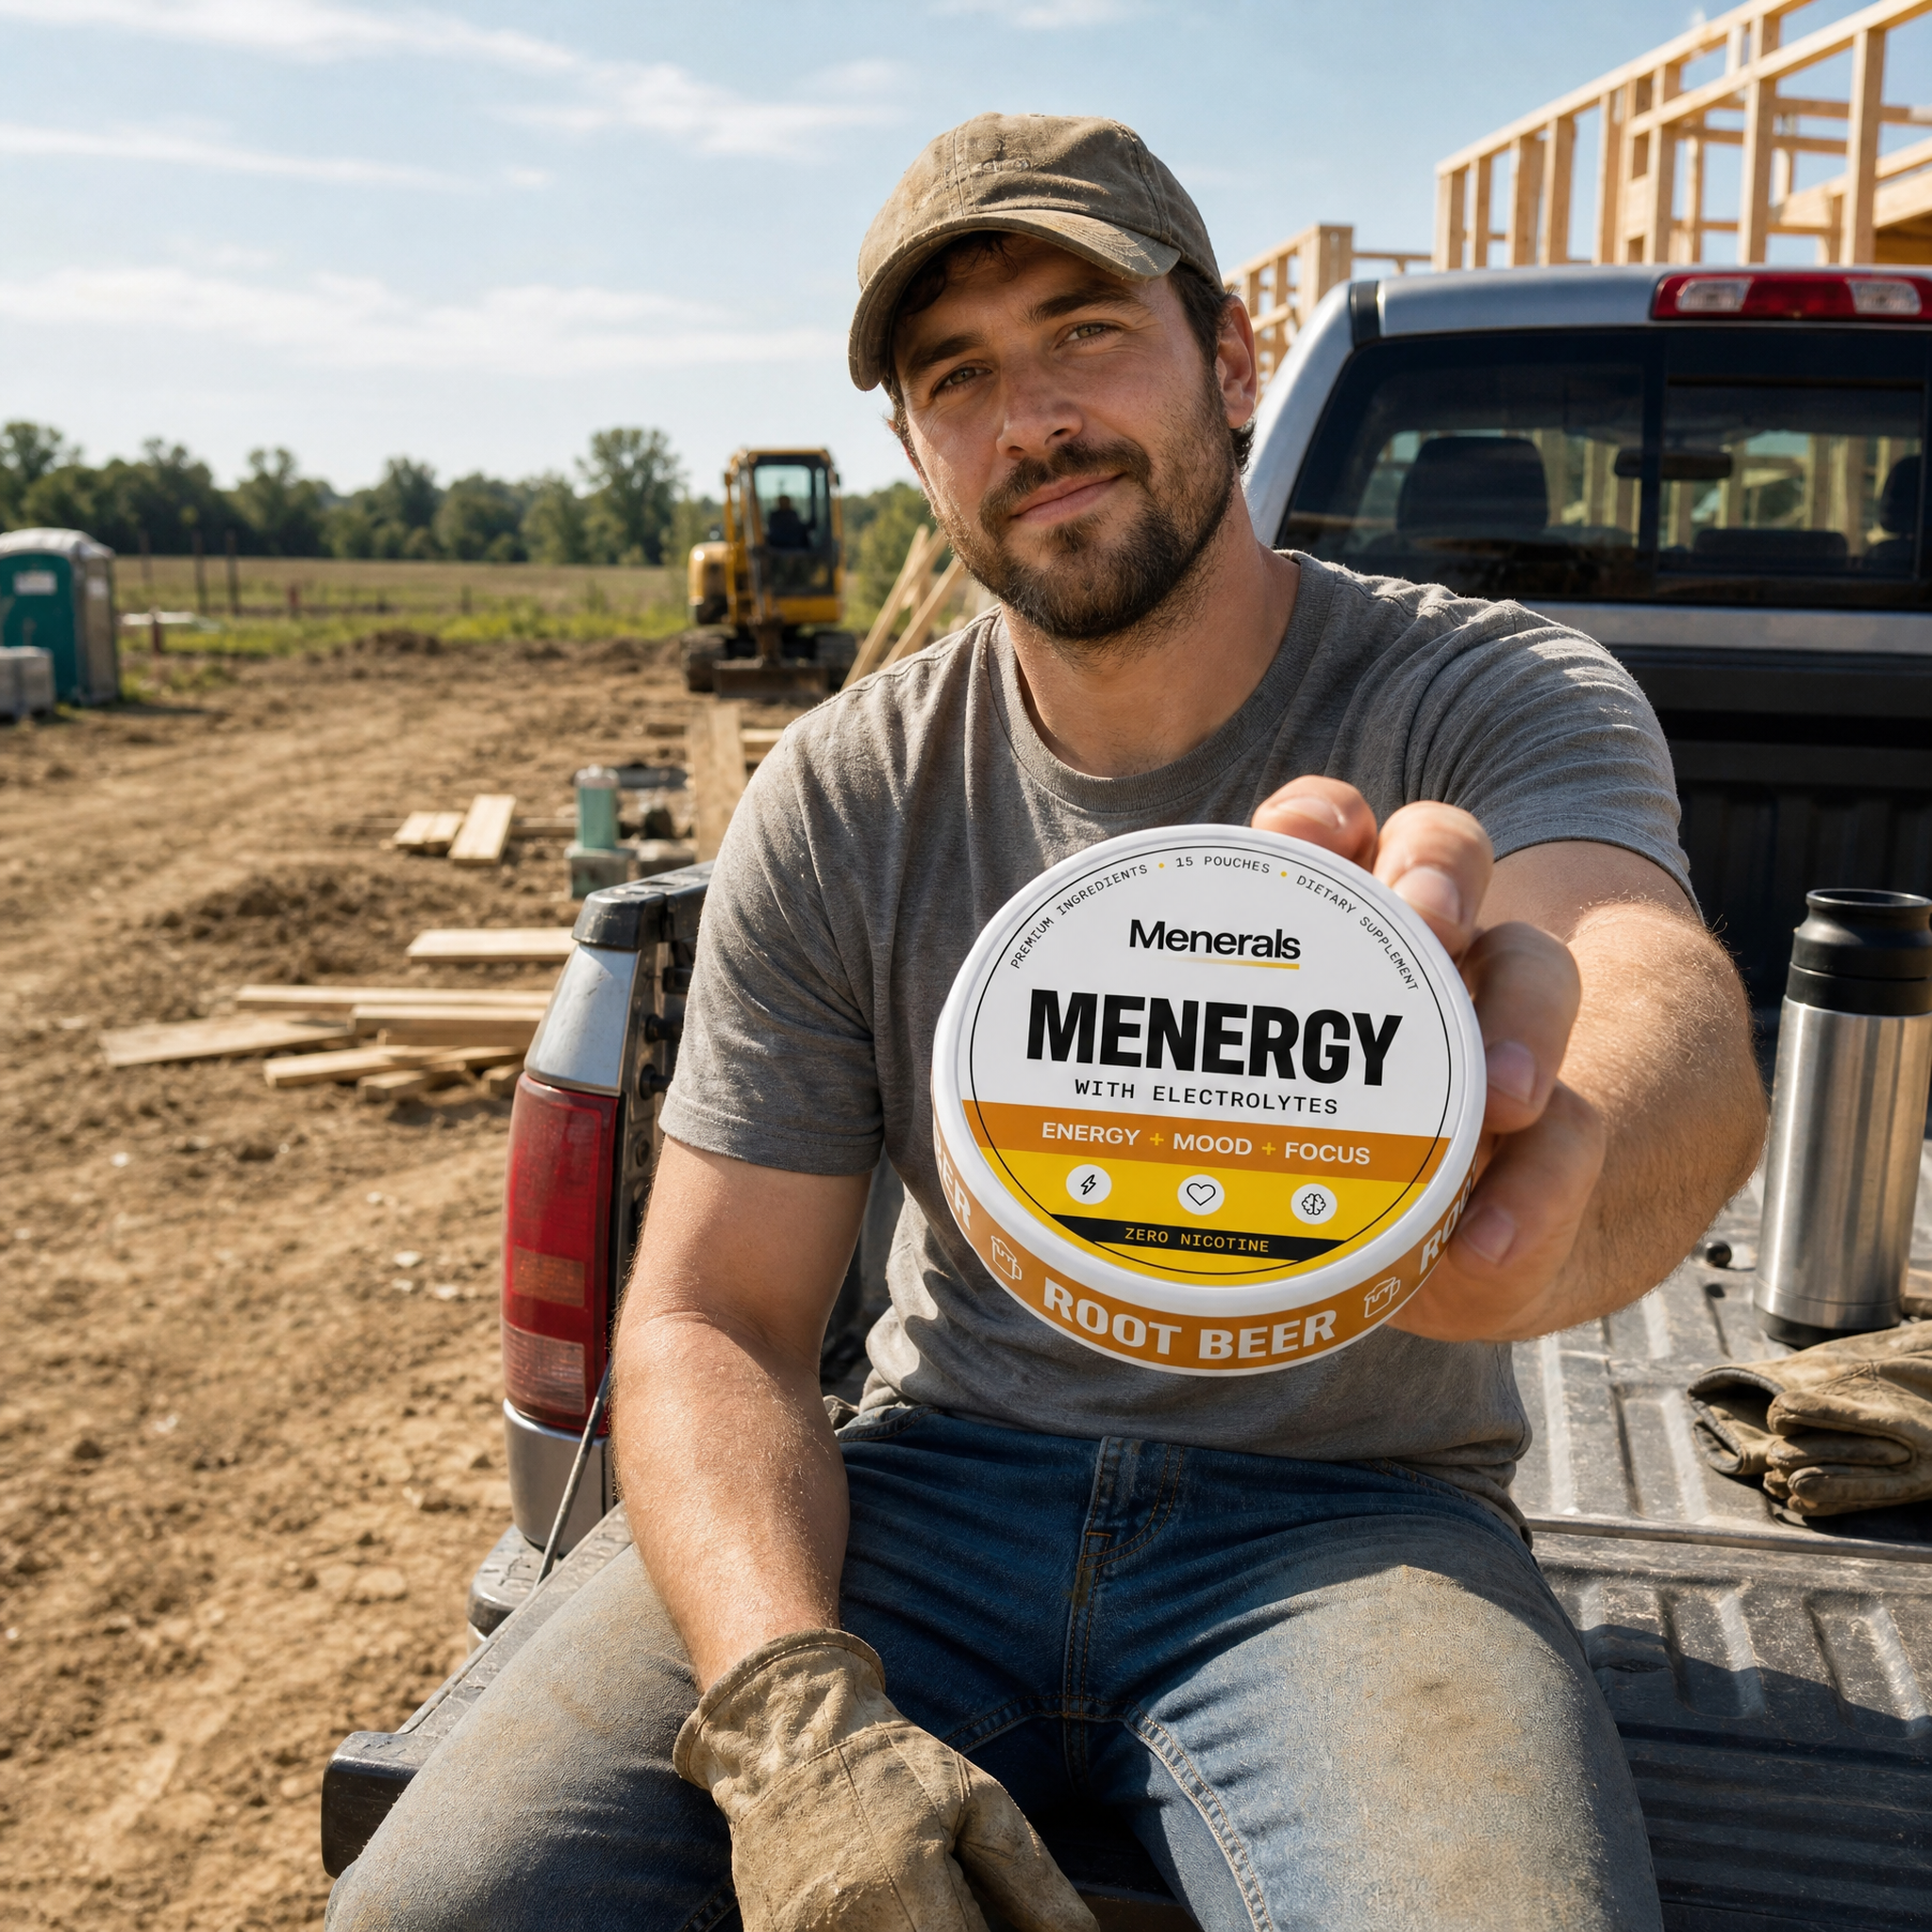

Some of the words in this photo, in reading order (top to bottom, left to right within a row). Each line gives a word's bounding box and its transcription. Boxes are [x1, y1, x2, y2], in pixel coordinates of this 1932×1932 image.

[1010, 916, 1055, 969] PREMIUM
[1056, 864, 1148, 916] INGREDIENTS
[1175, 856, 1193, 868] 15
[1204, 856, 1271, 874] POUCHES
[1296, 874, 1357, 914] DIETARY
[1359, 916, 1419, 991] SUPPLEMENT
[1129, 918, 1301, 960] Menerals
[1026, 989, 1404, 1087] MENERGY
[1074, 1078, 1135, 1099] WITH
[1153, 1085, 1339, 1115] ELECTROLYTES
[1041, 1122, 1141, 1146] ENERGY
[1173, 1133, 1253, 1156] MOOD
[1285, 1141, 1371, 1165] FOCUS
[1124, 1227, 1169, 1243] ZERO
[1180, 1233, 1270, 1253] NICOTINE
[1043, 1276, 1182, 1356] ROOT
[1198, 1309, 1338, 1360] BEER
